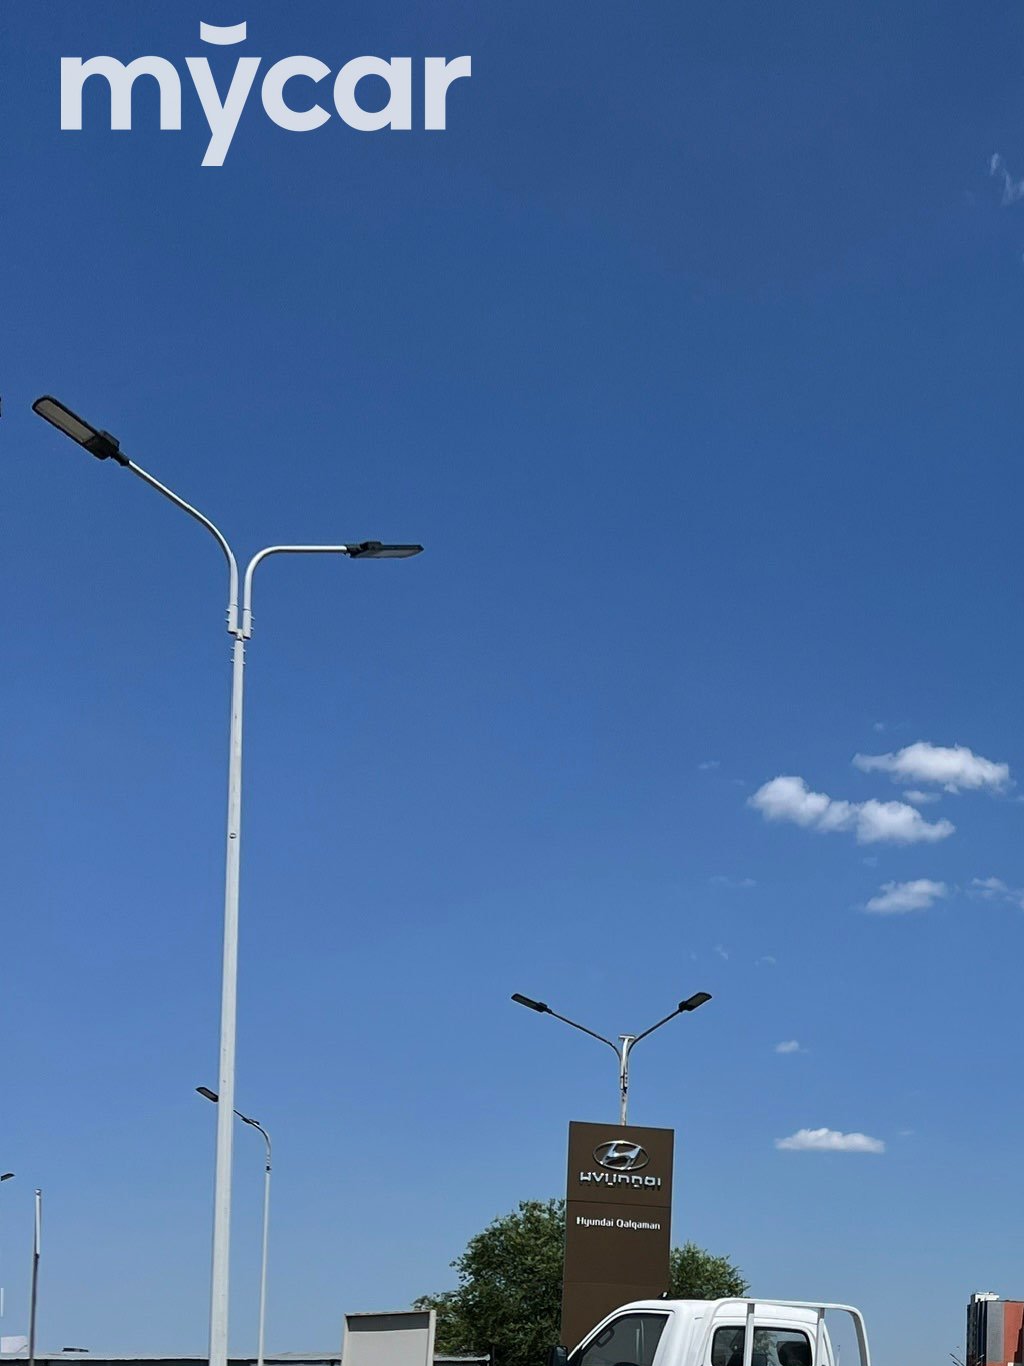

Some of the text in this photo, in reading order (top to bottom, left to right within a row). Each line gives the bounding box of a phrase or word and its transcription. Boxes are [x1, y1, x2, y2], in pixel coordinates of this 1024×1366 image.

[580, 1171, 661, 1188] HYUNDAI
[576, 1216, 661, 1230] Hyundai Qalqaman
